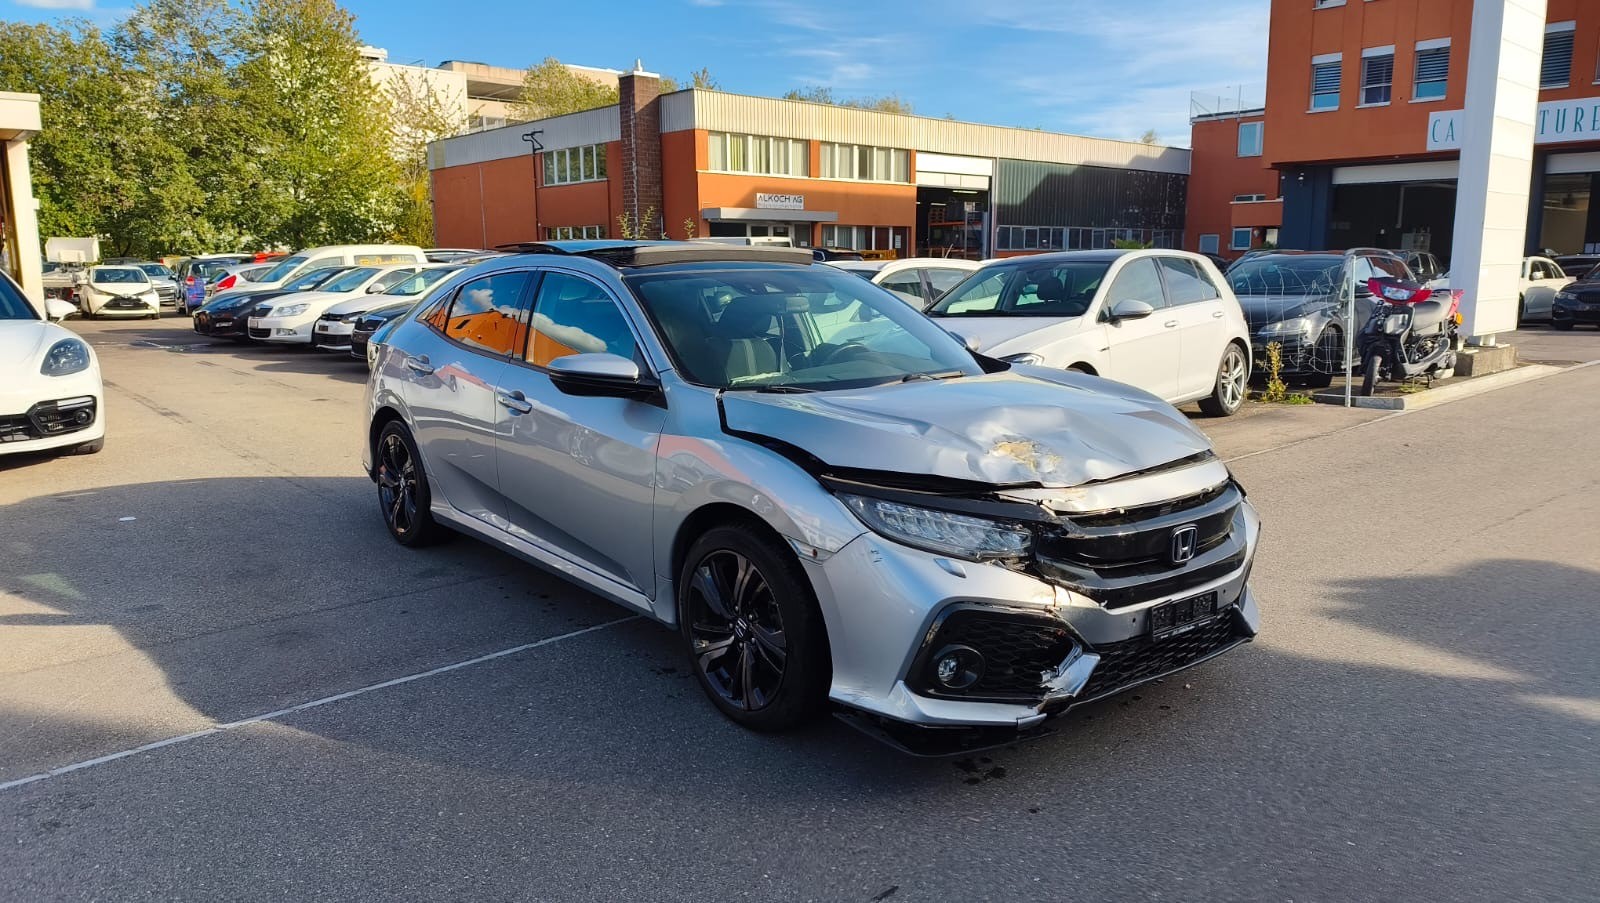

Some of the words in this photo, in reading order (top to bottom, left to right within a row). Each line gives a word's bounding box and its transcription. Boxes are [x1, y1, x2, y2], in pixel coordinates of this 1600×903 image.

[1432, 118, 1455, 142] CA
[1539, 105, 1600, 135] TURE
[792, 195, 803, 204] AG
